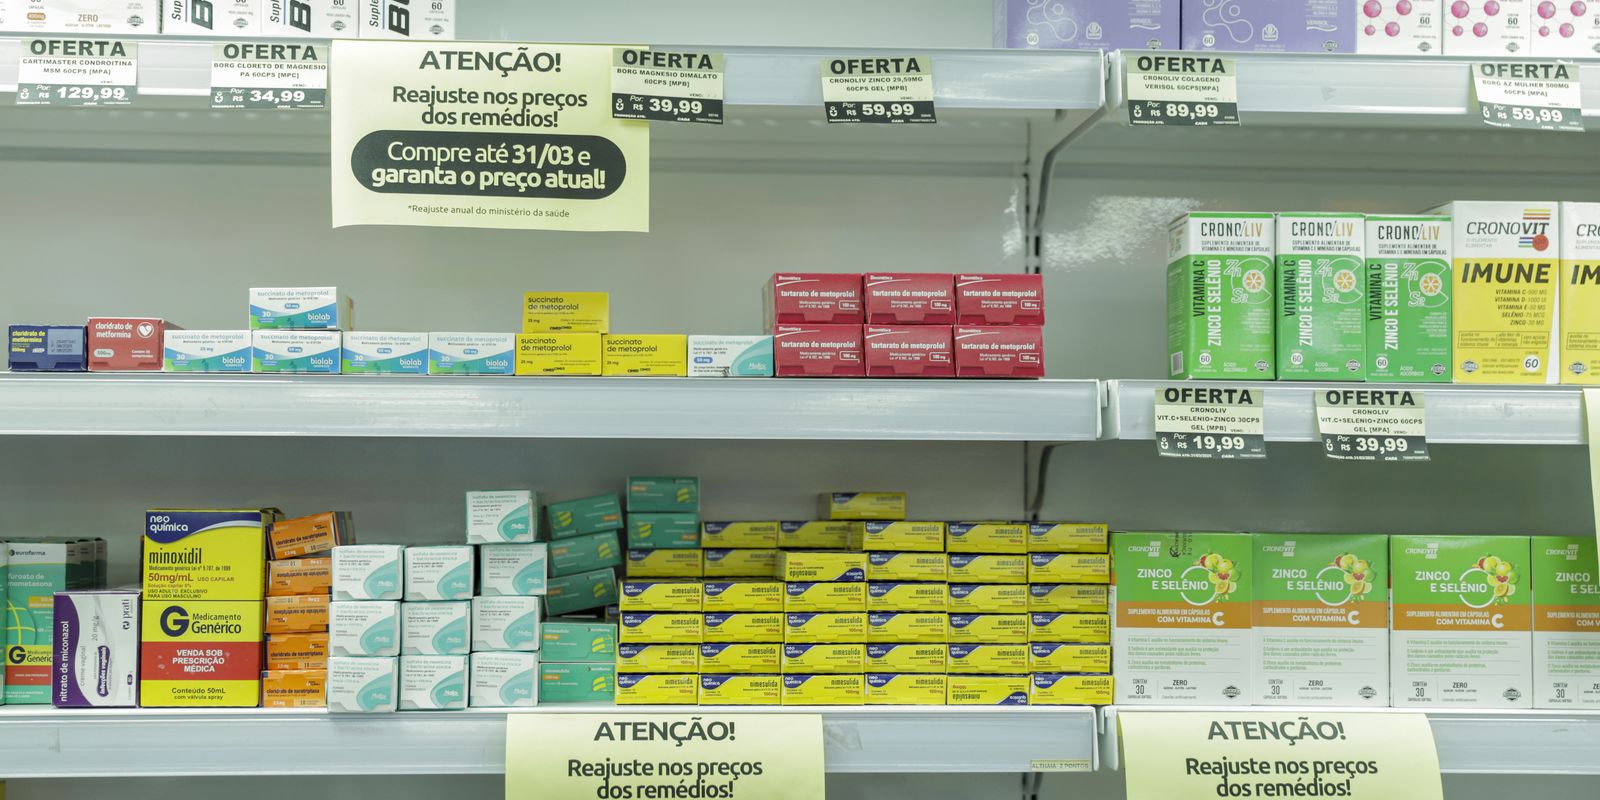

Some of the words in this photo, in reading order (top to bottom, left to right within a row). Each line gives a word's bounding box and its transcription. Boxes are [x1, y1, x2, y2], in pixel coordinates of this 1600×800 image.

[30, 40, 126, 56] OFERTA
[223, 44, 318, 61] OFERTA
[419, 47, 561, 77] ATENÇÃO!
[622, 50, 714, 70] OFERTA
[830, 58, 921, 74] OFERTA
[1137, 56, 1225, 74] OFERTA
[639, 70, 678, 78] MAGNESIO
[680, 72, 718, 80] DIMALATO
[1480, 63, 1570, 79] OFERTA
[669, 80, 690, 88] [MPB]
[56, 86, 126, 101] 129,99
[250, 90, 305, 104] 34,99
[392, 86, 479, 112] Reajuste
[483, 91, 516, 105] nos
[522, 92, 588, 110] preços
[650, 98, 702, 115] 39,99
[862, 104, 914, 118] 59,99
[1166, 104, 1218, 119] 89,99
[421, 106, 459, 125] dos
[461, 108, 559, 128] remédios!
[1512, 107, 1563, 123] 59,99
[387, 142, 471, 166] Compre
[474, 142, 509, 163] até
[512, 143, 574, 168] 31/03
[577, 150, 591, 165] e
[372, 166, 457, 187] garanta
[461, 172, 476, 186] o
[480, 172, 541, 192] preço
[544, 169, 606, 190] atual!
[450, 205, 474, 214] anual
[475, 206, 487, 215] do
[489, 206, 531, 216] ministério
[533, 208, 543, 217] da
[545, 208, 570, 218] saúde
[1466, 221, 1550, 235] CRONOVIT
[1206, 259, 1221, 304] SELÊNIO
[1461, 263, 1551, 284] IMUNE
[820, 290, 855, 298] metoprolol
[1193, 268, 1205, 317] VITAMINA
[539, 303, 579, 311] metoprolol
[308, 312, 330, 322] biolab
[95, 322, 123, 330] cloridrato
[124, 322, 132, 330] de
[1208, 315, 1221, 346] ZINCO
[96, 331, 131, 339] metformina
[1201, 355, 1210, 363] 60
[1525, 358, 1538, 368] 60
[1165, 388, 1253, 404] OFERTA
[1326, 390, 1415, 406] OFERTA
[1193, 436, 1244, 452] 19,99
[1355, 437, 1408, 454] 39,99
[150, 515, 170, 523] neo
[150, 523, 188, 534] química
[149, 548, 202, 564] minoxidil
[148, 573, 194, 583] 50mg/mL
[1137, 569, 1172, 579] ZINCO
[1152, 581, 1160, 590] E
[1161, 578, 1209, 591] SELÊNIO
[122, 599, 132, 618] prati
[192, 613, 241, 621] Medicamento
[1212, 612, 1224, 626] C
[192, 621, 242, 634] Genérico
[60, 621, 69, 661] miconazol
[60, 662, 68, 672] de
[172, 656, 224, 666] PRESCRIÇÃO
[184, 664, 215, 672] MÉDICA
[60, 673, 68, 702] nitrato
[1135, 685, 1144, 694] 30
[594, 717, 735, 746] ATENÇÃO!
[1208, 716, 1347, 746] ATENÇÃO!
[568, 758, 654, 781] Reajuste
[658, 762, 692, 776] nos
[697, 761, 762, 780] preços
[1185, 758, 1270, 781] Reajuste
[1275, 761, 1309, 775] nos
[1313, 760, 1378, 780] preços
[597, 777, 632, 799] dos
[637, 778, 734, 799] remédios!
[1216, 776, 1252, 797] dos
[1255, 778, 1351, 797] remédios!
